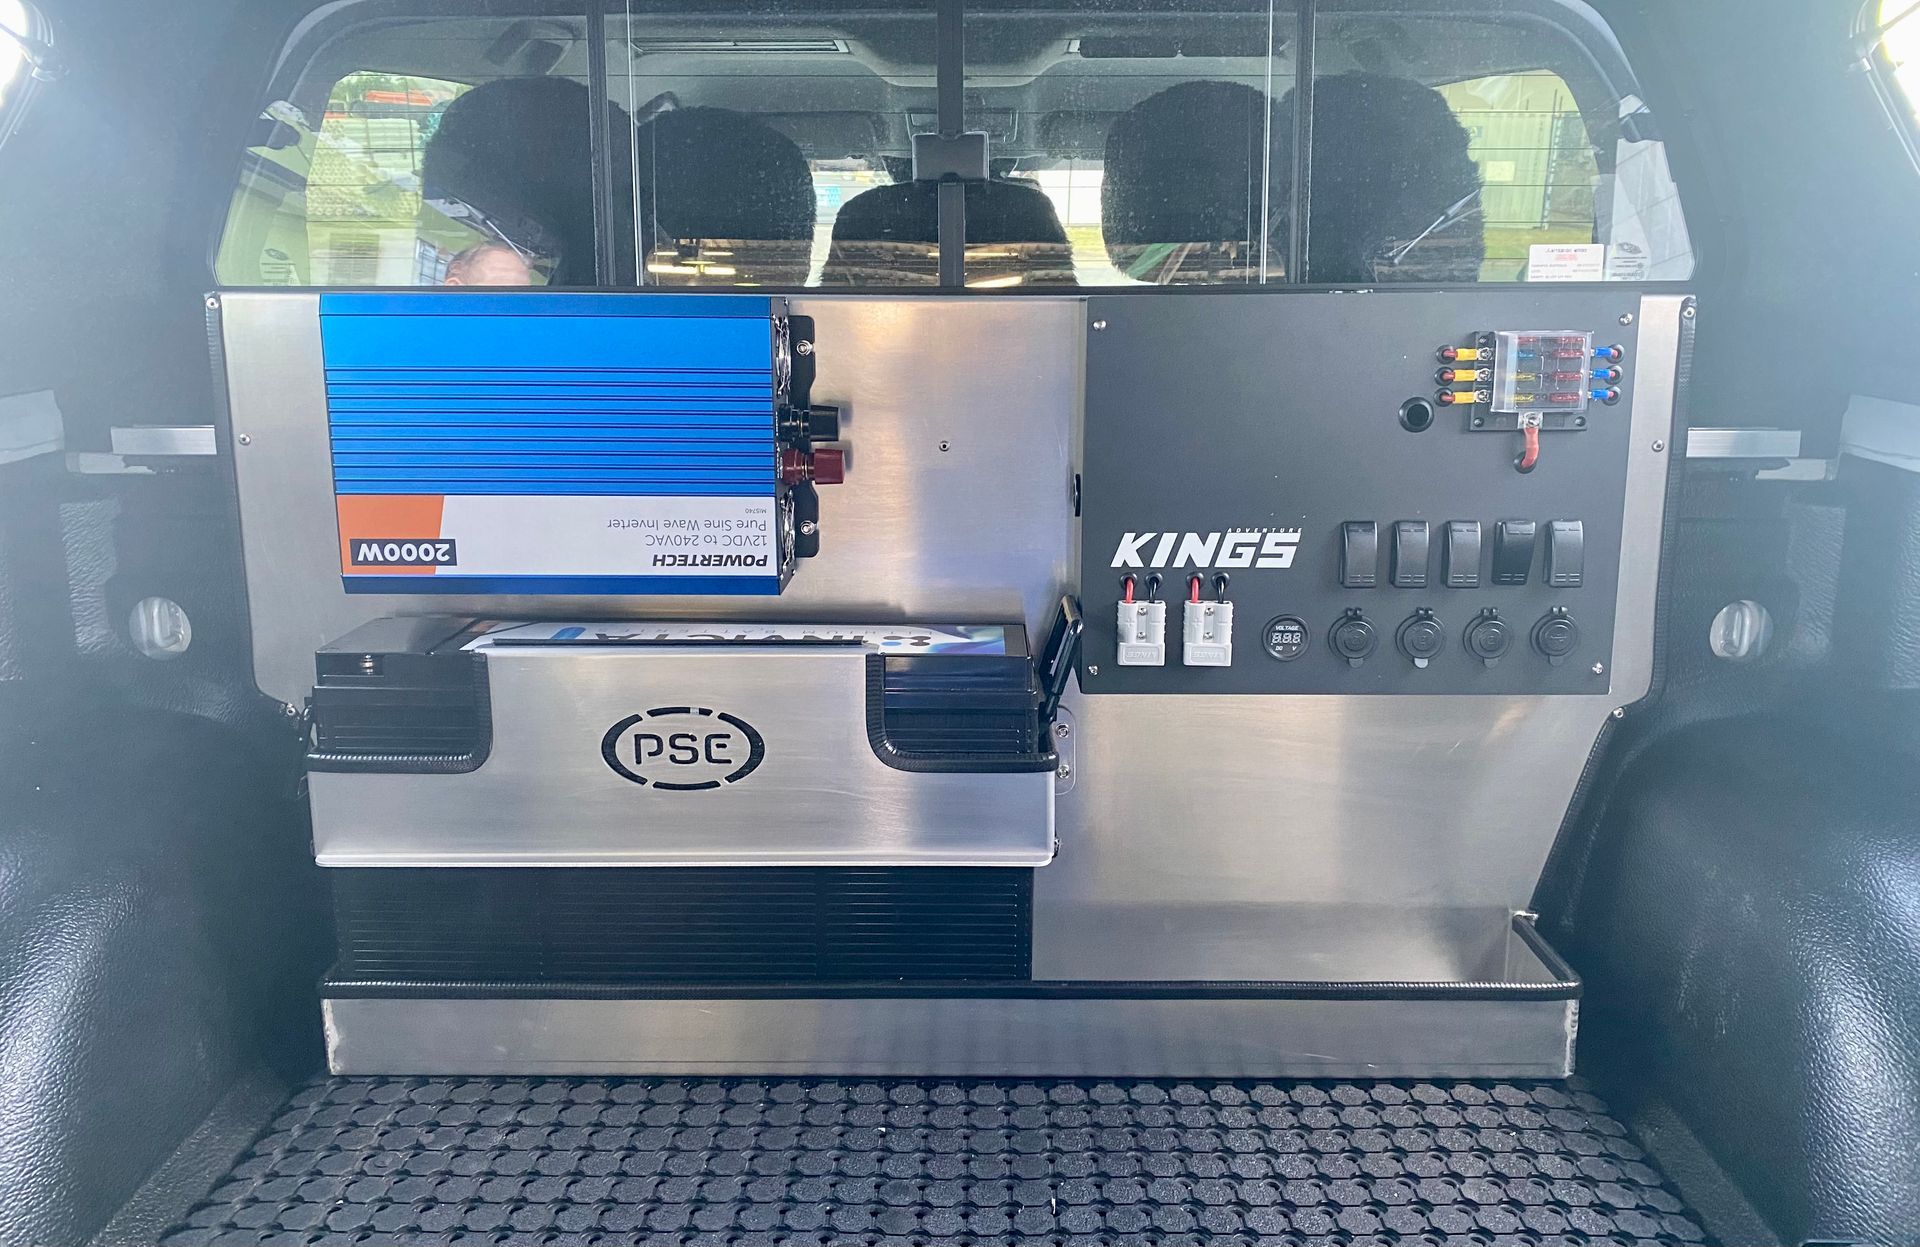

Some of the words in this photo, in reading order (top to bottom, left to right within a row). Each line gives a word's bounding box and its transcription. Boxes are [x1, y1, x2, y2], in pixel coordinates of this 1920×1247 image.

[607, 519, 659, 531] Inverter
[663, 519, 700, 531] Wave
[704, 519, 732, 532] Sine
[736, 520, 767, 532] Pure
[644, 534, 700, 547] 240VAC
[703, 535, 718, 545] to
[722, 534, 768, 547] 12VDC
[356, 543, 451, 562] 2000W
[1110, 532, 1302, 568] KINGS
[652, 554, 769, 567] POWERTECH
[634, 733, 733, 765] PSE
